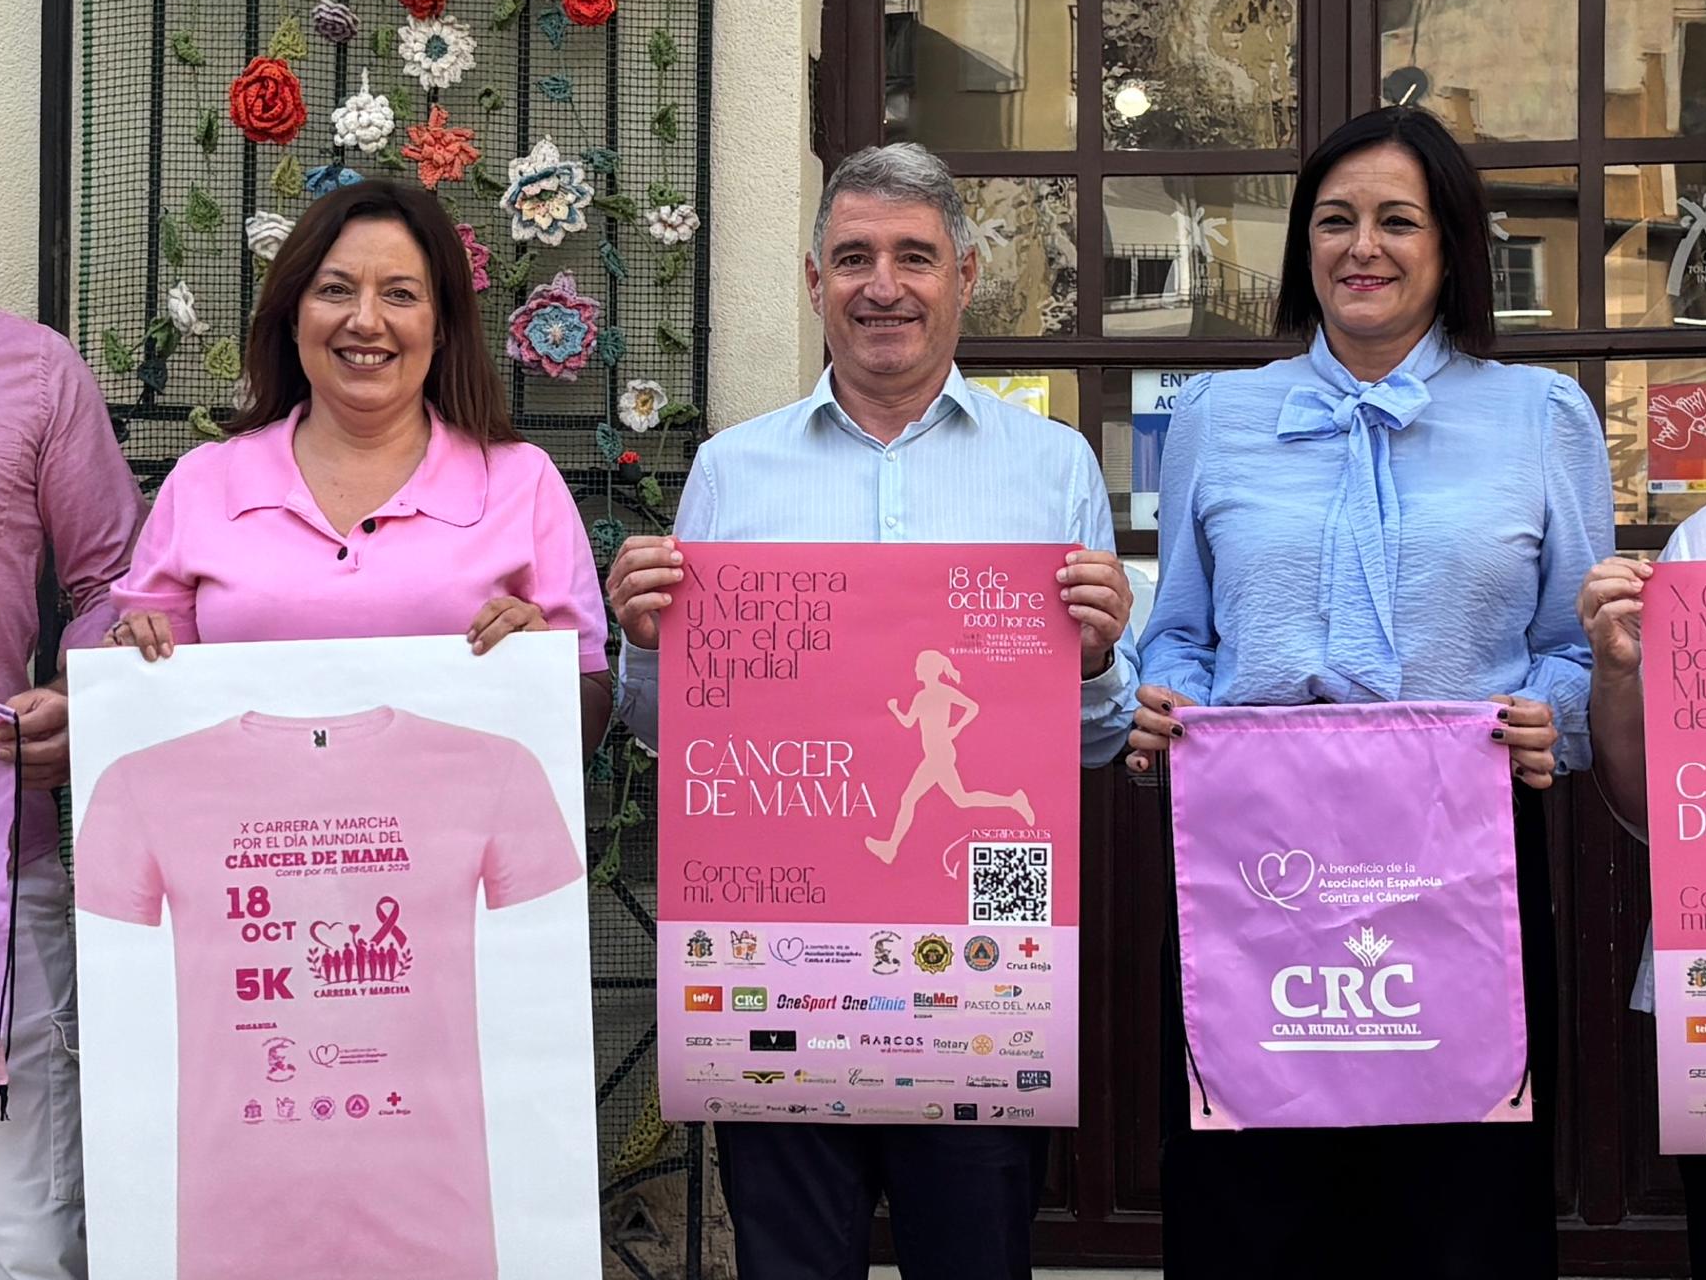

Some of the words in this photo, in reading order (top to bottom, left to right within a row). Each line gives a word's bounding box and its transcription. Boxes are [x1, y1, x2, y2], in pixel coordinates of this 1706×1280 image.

[717, 563, 847, 593] Carrera
[949, 566, 970, 590] 18
[977, 565, 1009, 590] de
[948, 587, 1045, 610] octubre
[1670, 583, 1691, 613] X
[687, 599, 704, 629] y
[713, 593, 831, 621] Marcha
[1001, 613, 1046, 628] horas
[687, 627, 742, 654] por
[752, 621, 777, 651] el
[1670, 620, 1689, 649] y
[686, 649, 798, 679] Mundial
[686, 678, 730, 708] del
[685, 734, 854, 778] CÁNCER
[685, 779, 736, 817] DE
[748, 781, 877, 818] MAMA
[240, 822, 250, 834] X
[253, 820, 319, 834] CARRERA
[323, 818, 332, 830] Y
[336, 816, 399, 830] MARCHA
[971, 828, 1052, 840] INSCRIPCIONES
[233, 838, 262, 850] POR
[266, 836, 280, 848] EL
[284, 832, 308, 848] DÍA
[311, 832, 375, 846] MUNDIAL
[379, 831, 403, 844] DEL
[225, 850, 307, 870] CÁNCER
[311, 850, 338, 866] DE
[341, 847, 410, 864] MAMA
[1318, 863, 1327, 873] A
[1329, 863, 1384, 874] beneficio
[1386, 862, 1402, 873] de
[684, 860, 762, 883] Corre
[771, 863, 816, 889] por
[1318, 877, 1384, 888] Asociación
[1387, 876, 1443, 890] Española
[226, 885, 271, 920] 18
[1319, 892, 1360, 903] Contra
[1362, 892, 1374, 903] el
[1376, 892, 1421, 902] Cáncer
[241, 920, 297, 943] OCT
[235, 966, 295, 1001] 5K
[1271, 963, 1421, 1018] CRC
[734, 994, 764, 1007] CRC
[777, 994, 837, 1012] OneSport
[841, 995, 906, 1011] OneClinic
[860, 1035, 924, 1046] MARCOS
[1272, 1023, 1306, 1035] CAJA
[1308, 1023, 1353, 1035] RURAL
[1355, 1023, 1421, 1035] CENTRAL
[933, 1038, 969, 1050] Rotary
